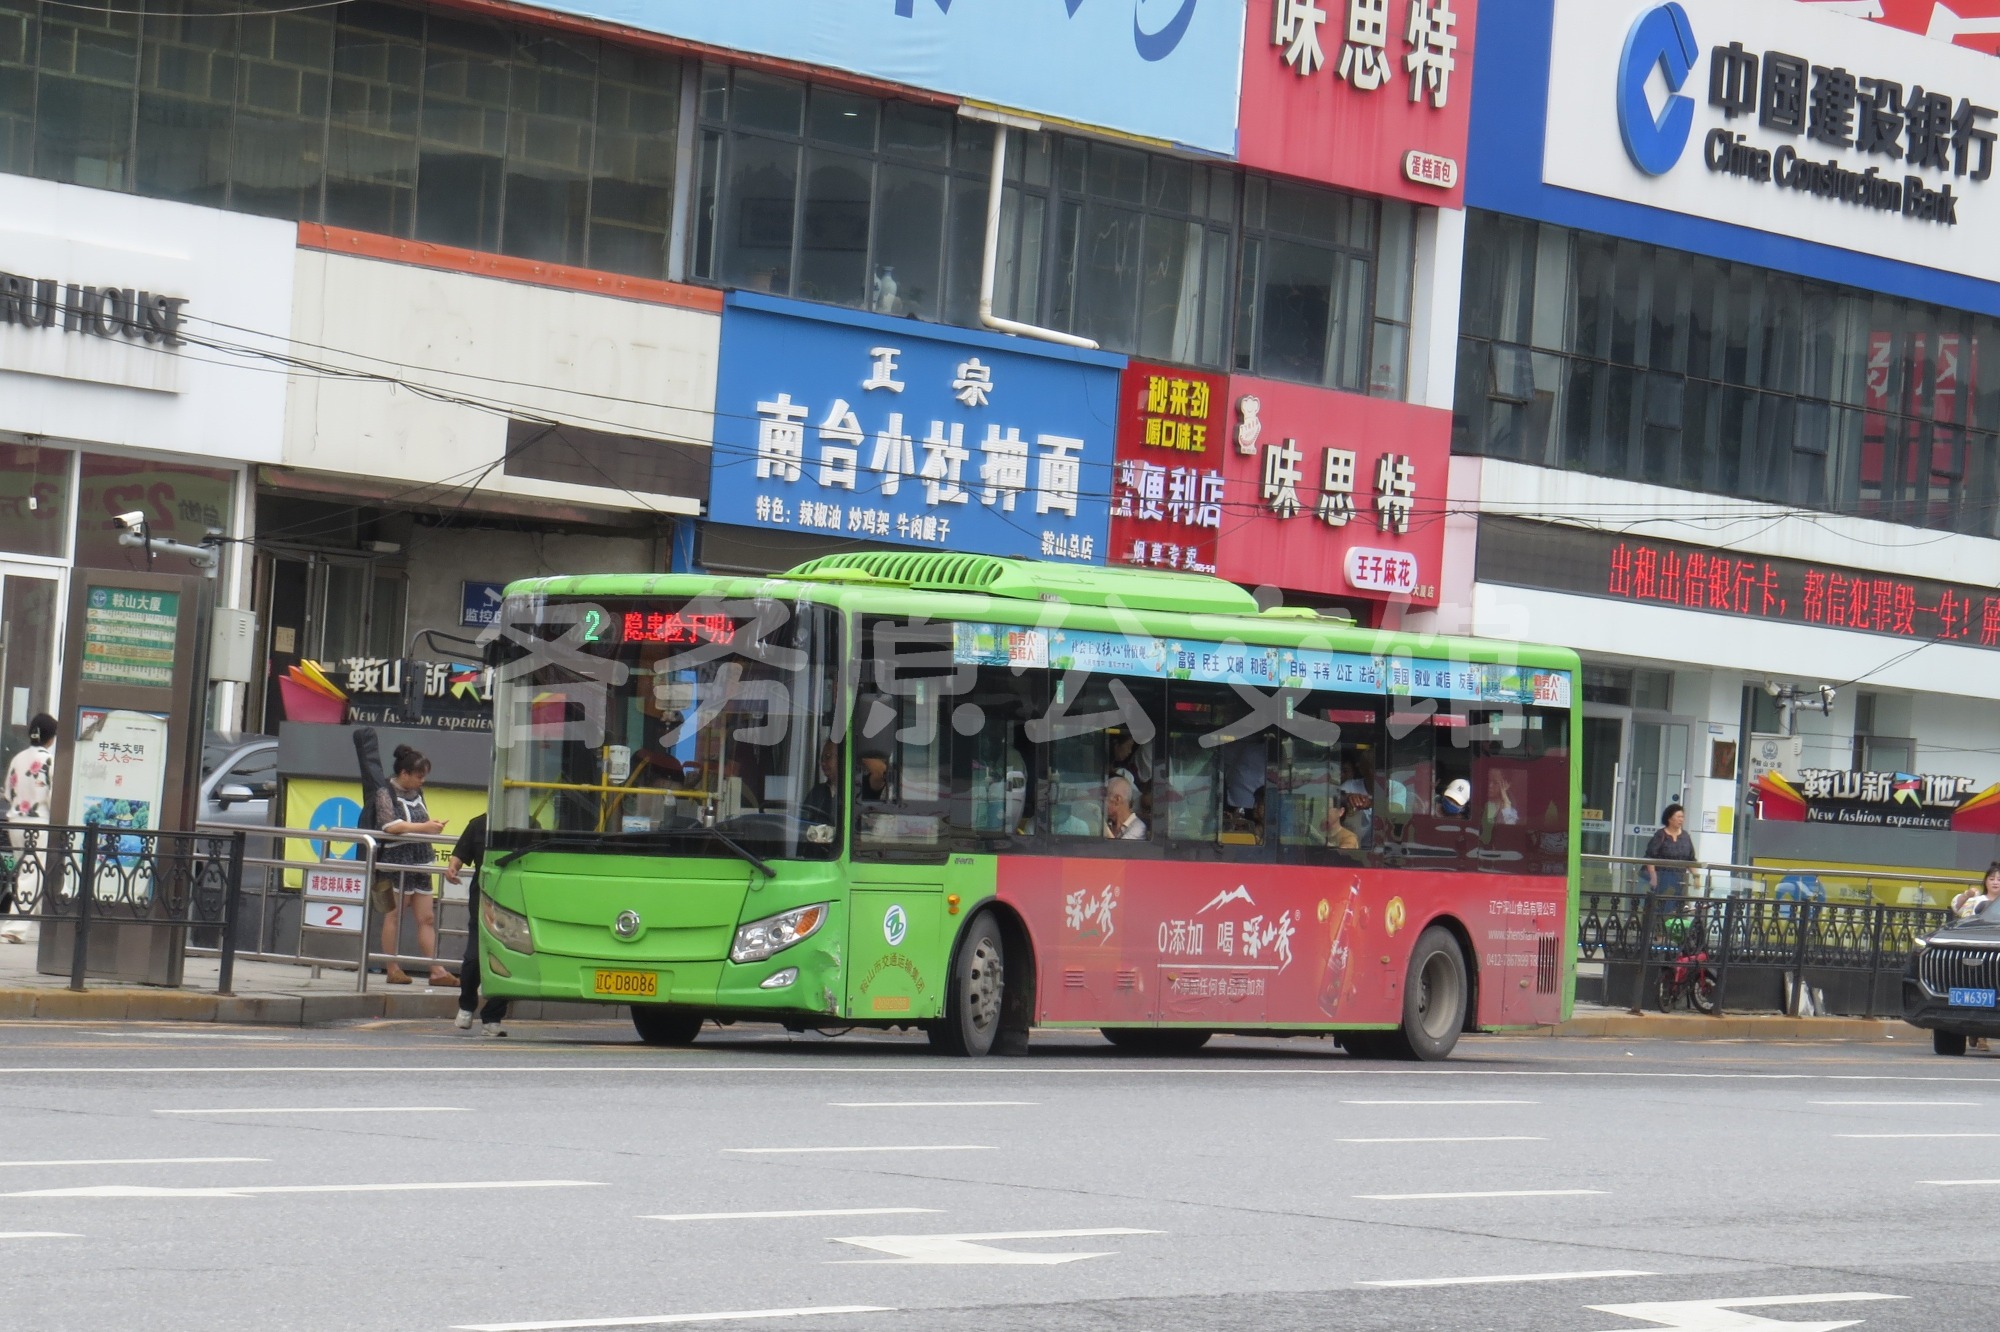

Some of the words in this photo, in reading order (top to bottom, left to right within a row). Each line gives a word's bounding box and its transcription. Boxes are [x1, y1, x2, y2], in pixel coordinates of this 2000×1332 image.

[1270, 0, 1458, 108] 味思特
[1708, 41, 1999, 181] 中国建设银行
[1412, 155, 1451, 183] 蛋糕面包
[1704, 128, 1771, 182] China
[1773, 144, 1903, 212] Construction
[1902, 175, 1959, 226] Bank
[64, 284, 190, 347] HOUSE
[862, 347, 994, 407] 正宗
[756, 393, 1084, 517] 南台小杜抻面
[1137, 461, 1225, 528] 便利店
[1259, 438, 1416, 534] 味思特
[848, 506, 890, 537] 炒鸡架
[1041, 530, 1094, 561] 鞍山总店
[1131, 539, 1197, 569] 烟草专卖
[1356, 555, 1411, 587] 王子麻花
[112, 593, 162, 612] 鞍山大厦
[584, 610, 600, 642] 2
[1178, 651, 1196, 670] 富强
[1202, 653, 1220, 672] 民主
[1226, 655, 1244, 674] 文明
[1250, 657, 1268, 676] 和谐
[1290, 661, 1307, 678] 自由
[1313, 662, 1330, 681] 平等
[1336, 664, 1353, 682] 公正
[1358, 666, 1375, 684] 法治
[1393, 667, 1410, 686] 爱国
[1414, 669, 1431, 688] 敬业
[1435, 671, 1451, 689] 诚信
[1458, 673, 1474, 690] 友善
[98, 752, 144, 763] 天人合一
[99, 742, 144, 755] 中华文明
[311, 875, 362, 894] 请您排队乘车
[325, 905, 343, 926] 2
[1157, 920, 1204, 956] 0添加
[1217, 921, 1234, 956] 喝
